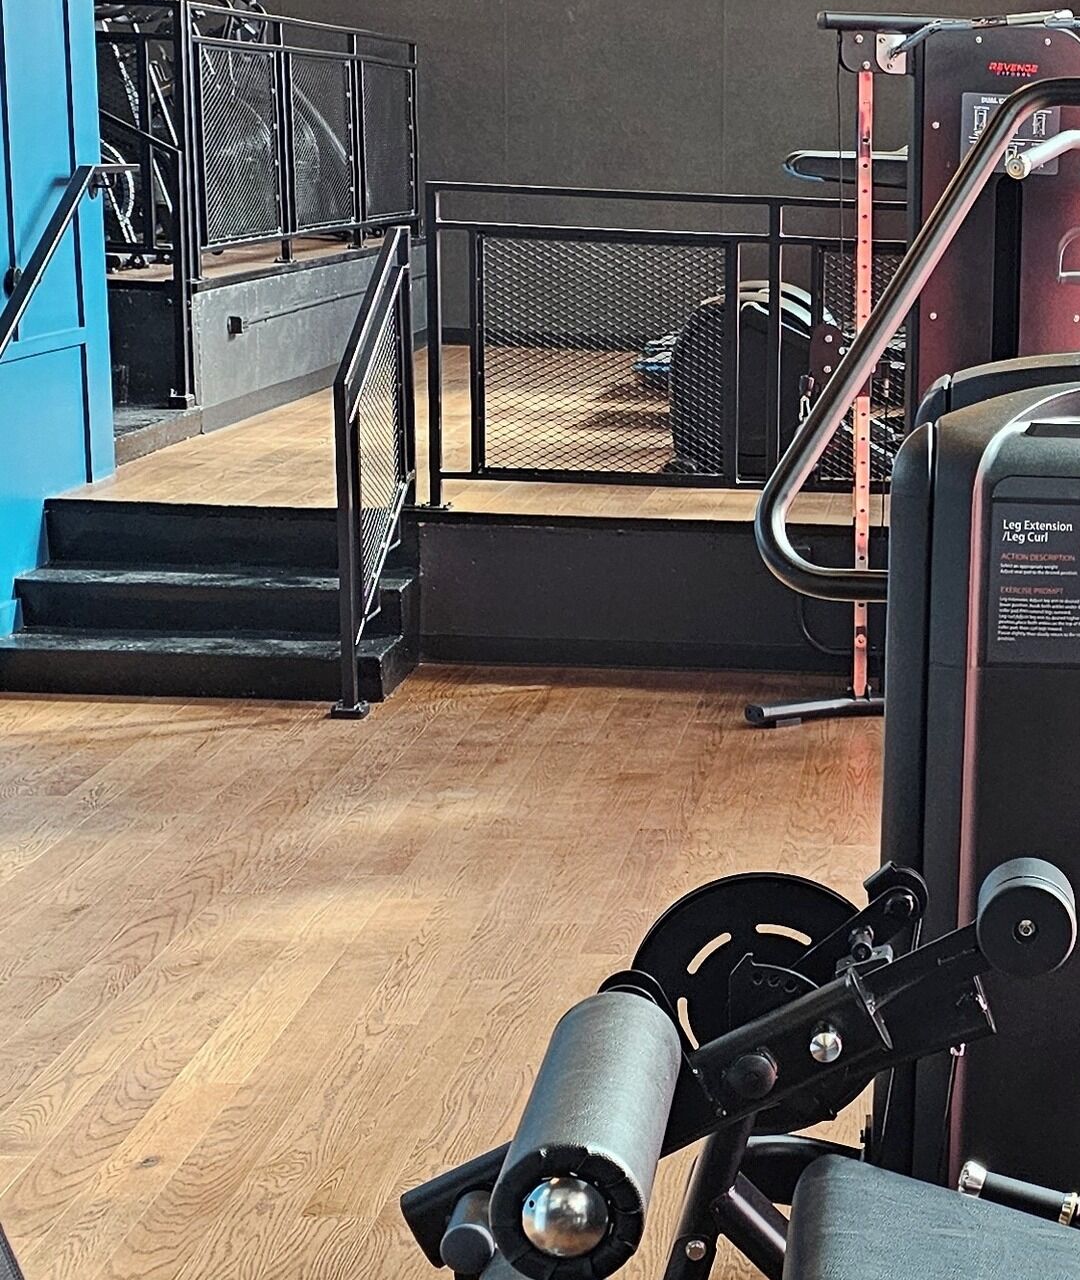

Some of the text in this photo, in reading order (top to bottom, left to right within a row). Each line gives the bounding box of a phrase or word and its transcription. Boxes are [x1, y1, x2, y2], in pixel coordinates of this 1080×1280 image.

[988, 62, 1039, 73] REVENGE
[981, 96, 998, 104] DUAL
[1003, 520, 1073, 532] Leg Extension
[1002, 531, 1049, 544] /Leg Curl
